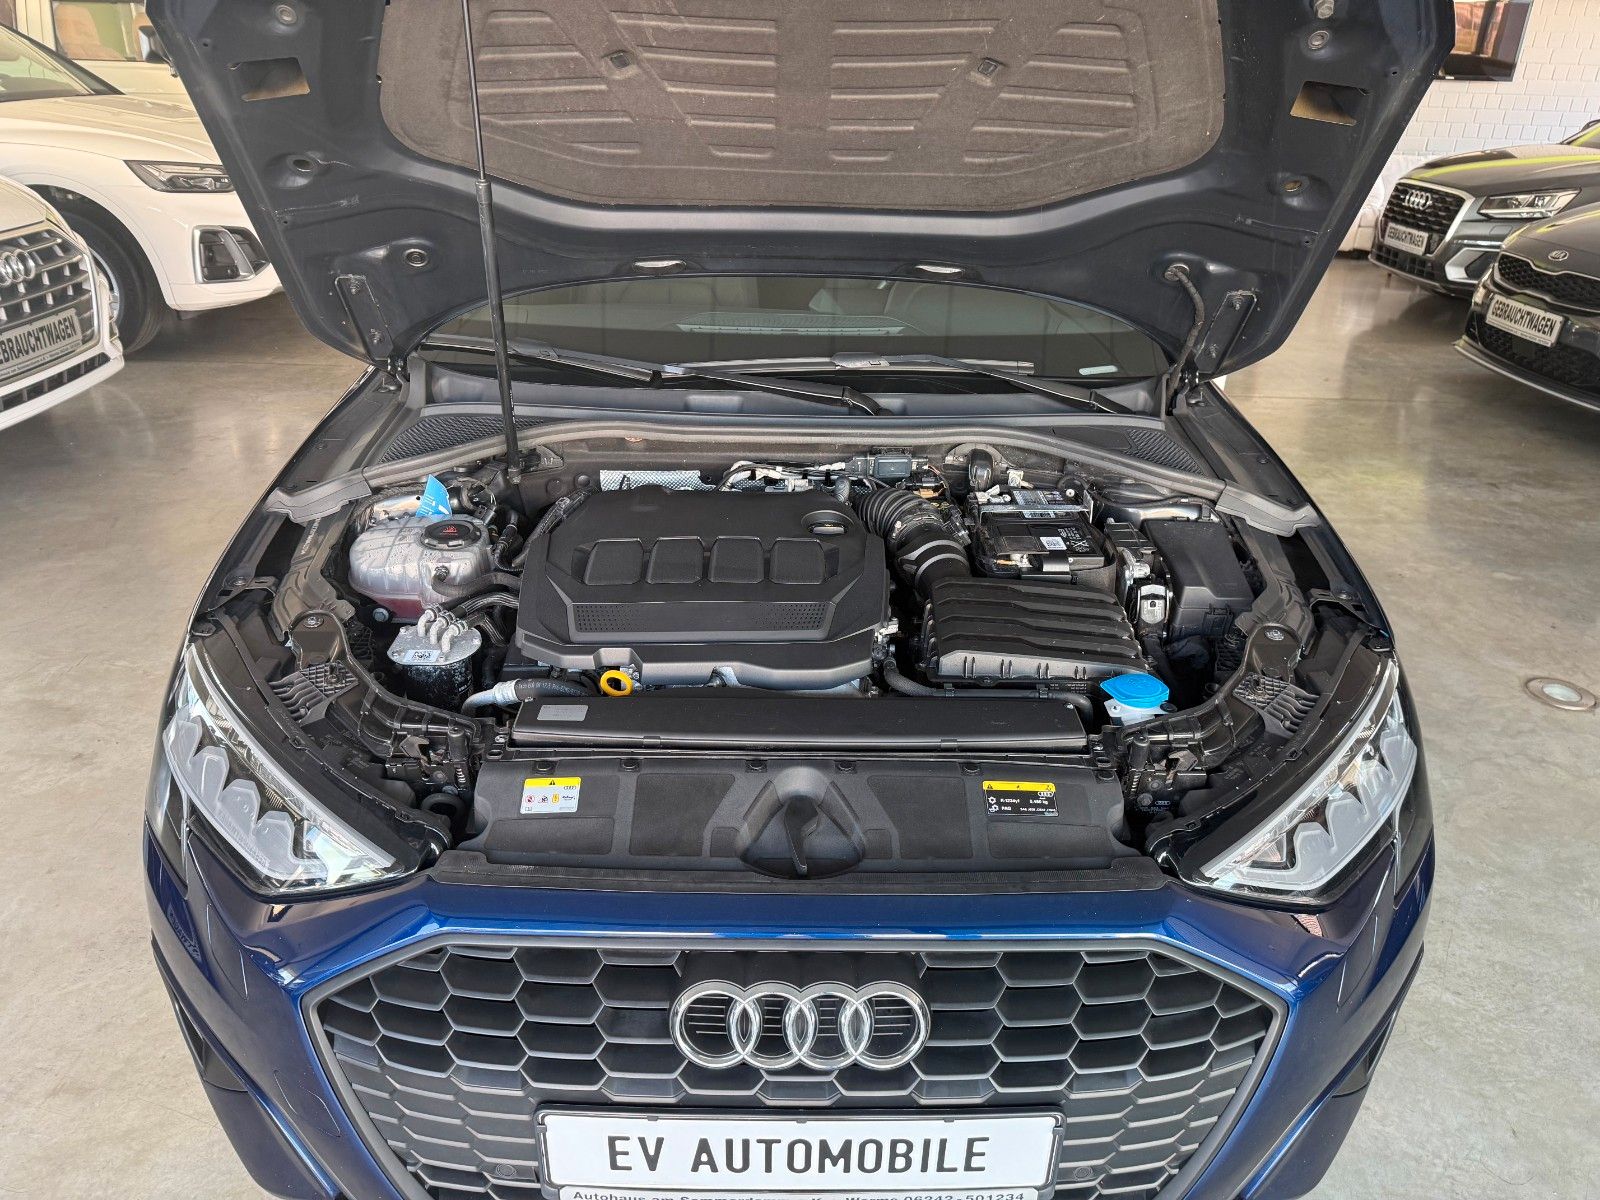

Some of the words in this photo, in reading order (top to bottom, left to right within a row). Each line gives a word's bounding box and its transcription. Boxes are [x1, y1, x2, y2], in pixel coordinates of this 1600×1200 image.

[1491, 299, 1557, 337] GEBRAUCHTWAGEN
[0, 314, 77, 364] BRAUCHTWAGEN
[607, 1135, 665, 1172] EV
[690, 1136, 990, 1174] AUTOMOBILE
